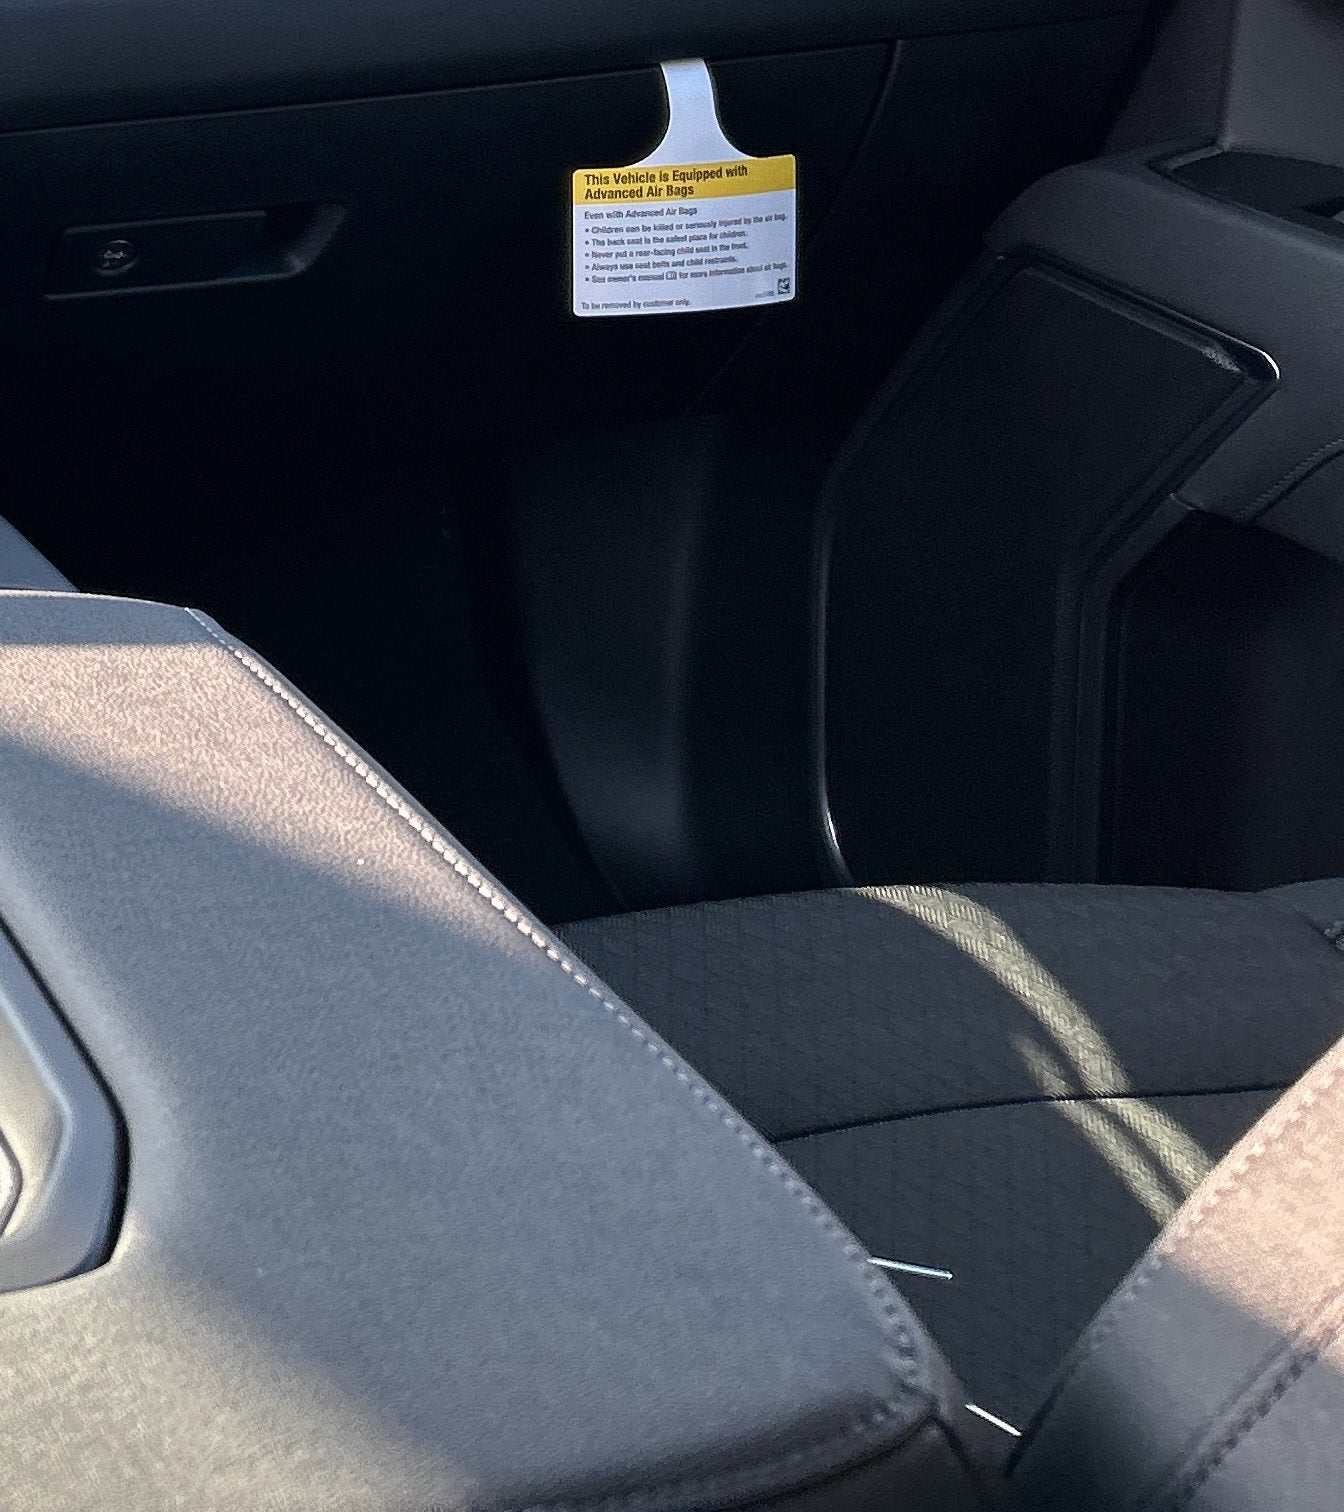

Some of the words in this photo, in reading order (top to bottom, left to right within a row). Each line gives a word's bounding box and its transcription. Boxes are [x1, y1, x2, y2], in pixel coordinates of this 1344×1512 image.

[584, 173, 610, 186] This
[613, 171, 656, 185] Vehicle
[672, 166, 723, 183] Equipped
[725, 164, 748, 178] with
[584, 185, 643, 200] Advanced
[646, 184, 663, 197] Air
[666, 184, 695, 198] Bags
[584, 210, 604, 220] Even
[606, 210, 624, 219] with
[625, 208, 664, 218] Advanced
[665, 207, 676, 216] Air
[678, 206, 698, 216] Bags
